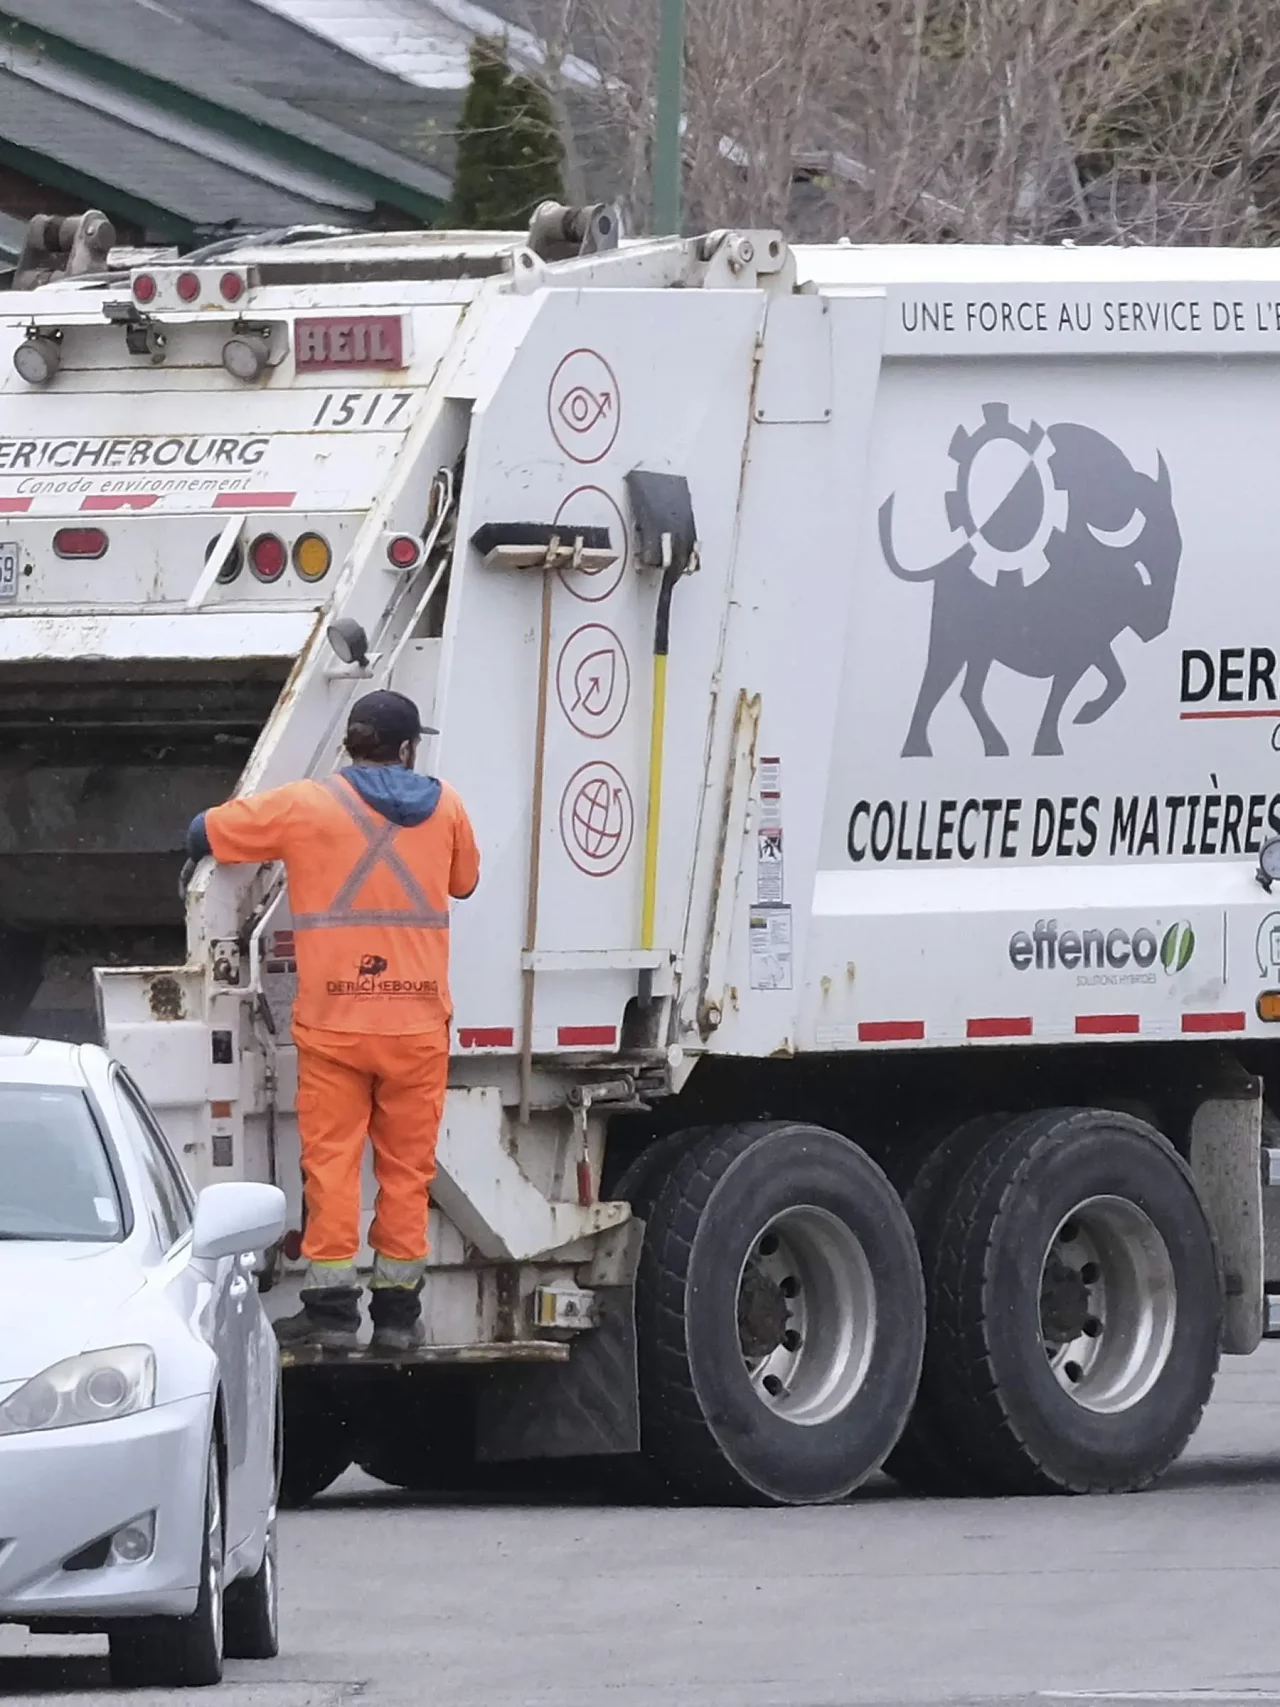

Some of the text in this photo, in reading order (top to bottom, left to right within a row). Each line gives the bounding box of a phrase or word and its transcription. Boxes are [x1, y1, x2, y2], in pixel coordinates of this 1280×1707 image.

[902, 302, 955, 332] UNE
[966, 301, 1048, 332] FORCE
[1058, 302, 1092, 332] AU
[1103, 301, 1202, 332] SERVICE
[1213, 302, 1245, 331] DE
[299, 324, 394, 362] HEIL
[312, 392, 415, 427] 1517
[16, 476, 252, 495] Canada environnement
[847, 798, 1023, 862] COLLECTE
[1031, 796, 1100, 858] DES
[1008, 919, 1158, 971] effenco
